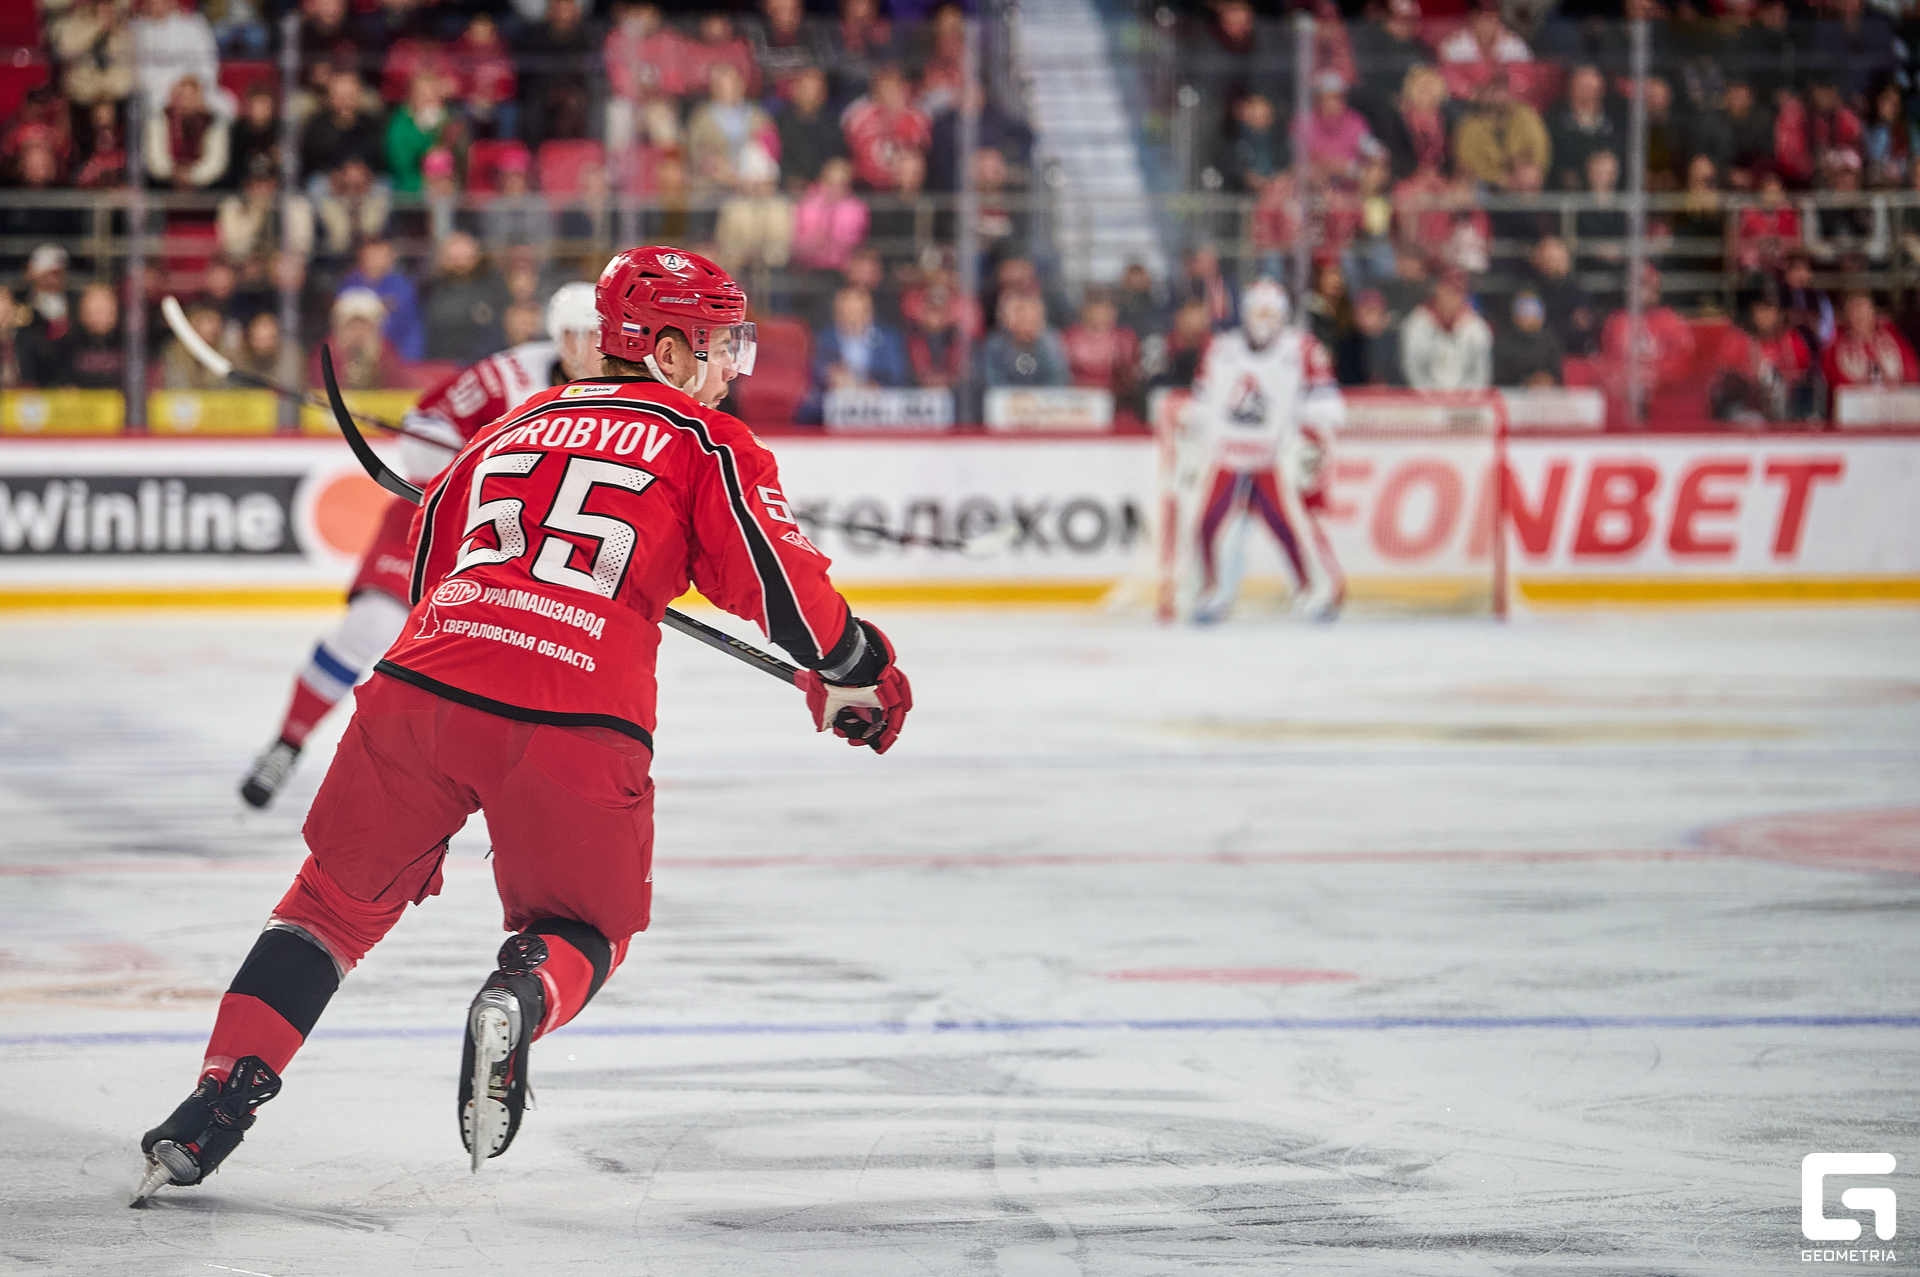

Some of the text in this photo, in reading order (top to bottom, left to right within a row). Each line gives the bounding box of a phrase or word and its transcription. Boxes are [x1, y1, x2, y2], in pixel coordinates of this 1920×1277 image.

[0, 479, 285, 552] Winline
[444, 451, 658, 600] 55
[794, 495, 1148, 556] телеко
[479, 587, 607, 640] УРАЛМАШЗАВОД
[442, 619, 596, 673] СВЕРДЛОВСКАЯ ОБЛАСТЬ
